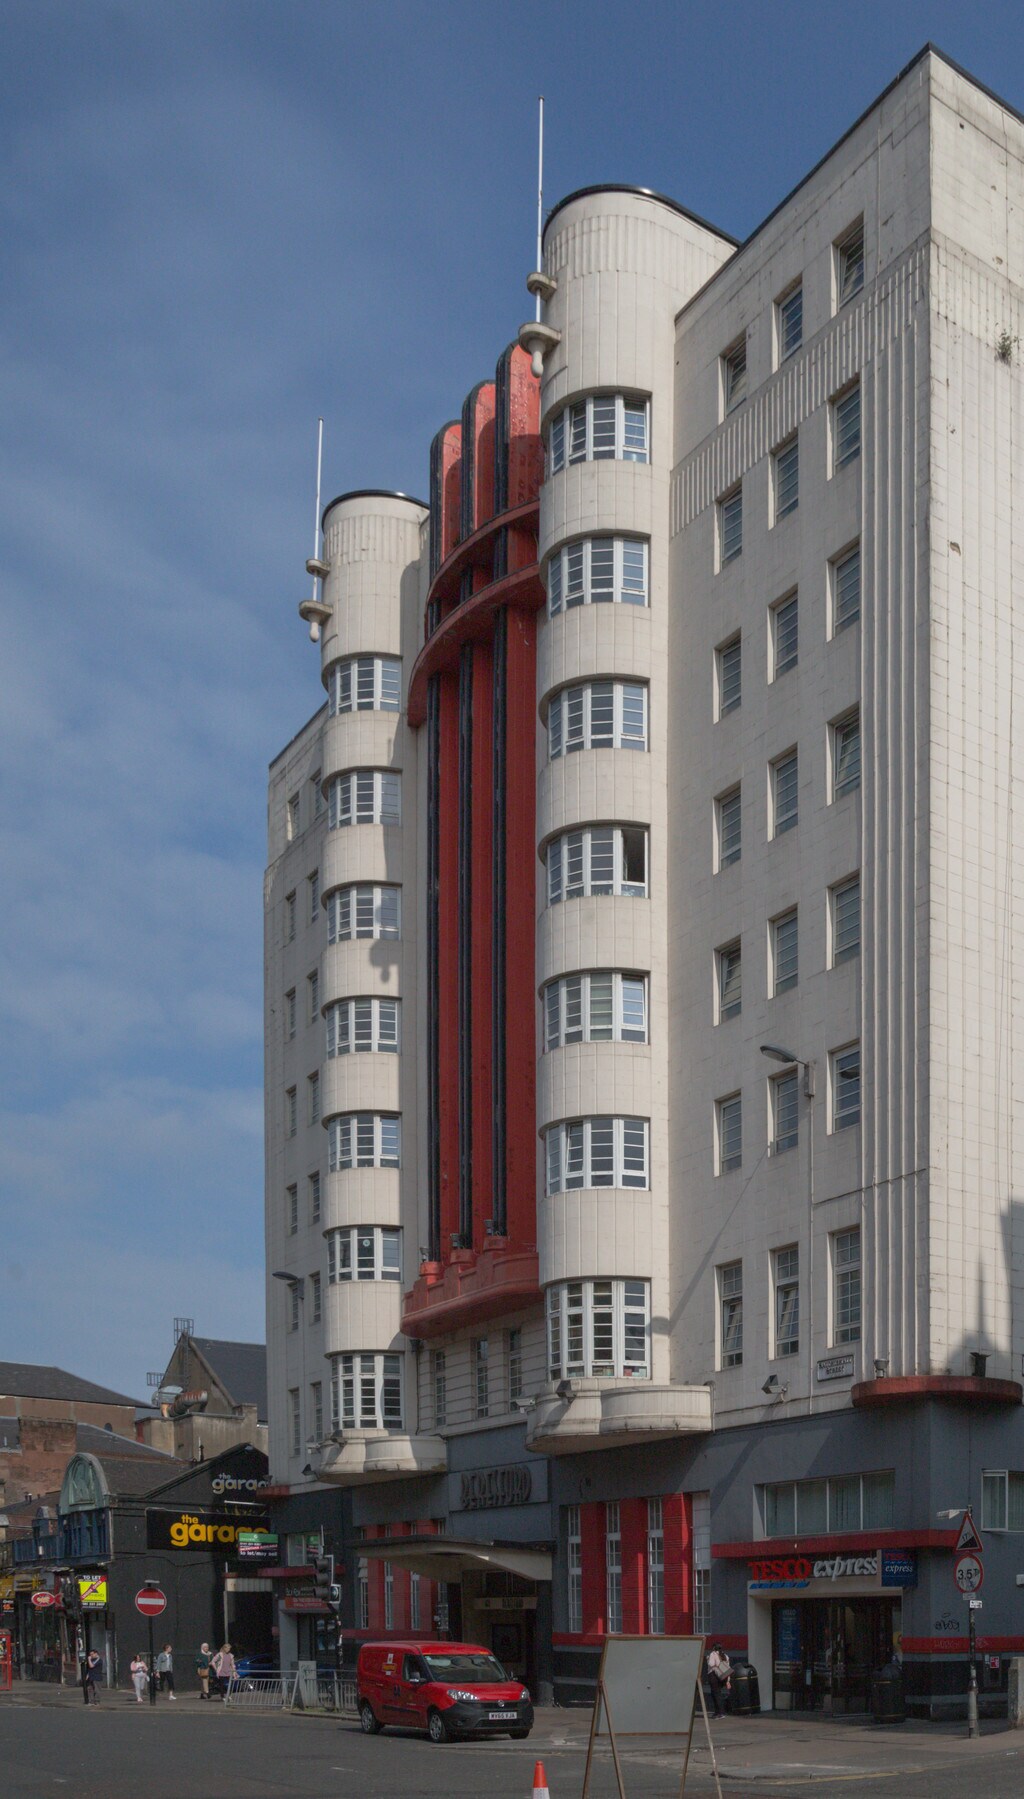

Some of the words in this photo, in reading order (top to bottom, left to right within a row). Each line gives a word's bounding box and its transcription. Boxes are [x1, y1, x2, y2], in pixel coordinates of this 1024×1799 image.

[181, 1514, 199, 1524] the
[748, 1557, 813, 1581] TESCO
[813, 1556, 877, 1582] express
[885, 1564, 913, 1575] express
